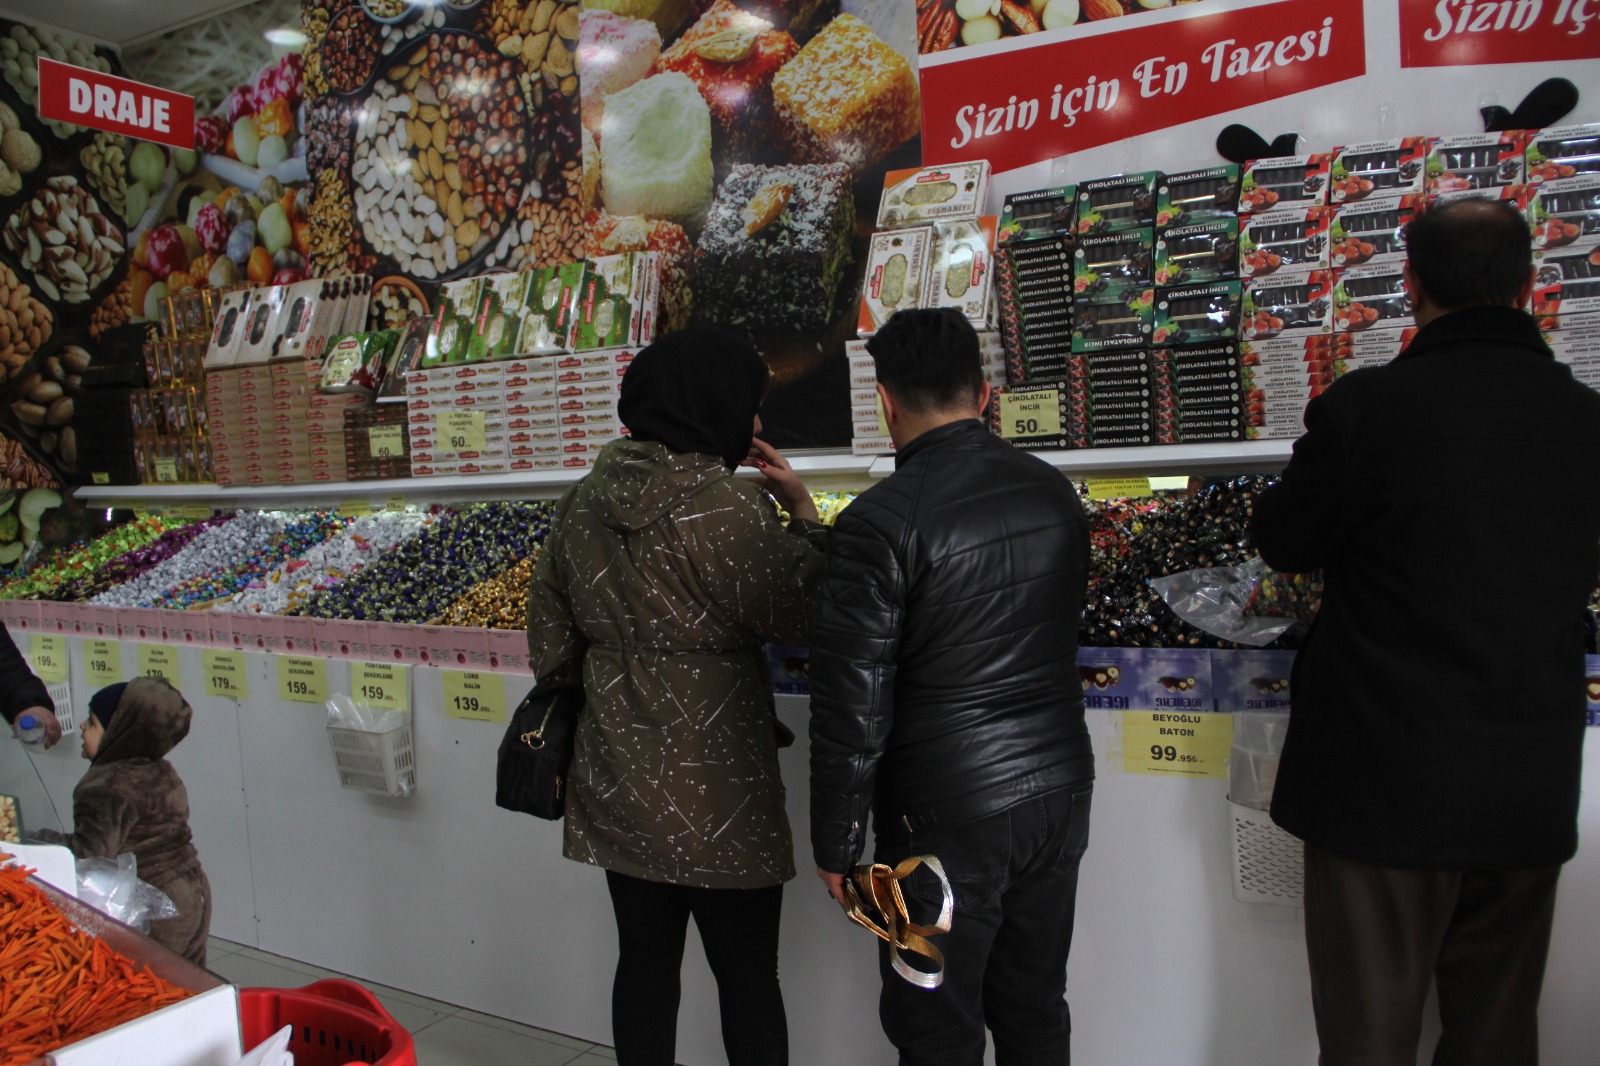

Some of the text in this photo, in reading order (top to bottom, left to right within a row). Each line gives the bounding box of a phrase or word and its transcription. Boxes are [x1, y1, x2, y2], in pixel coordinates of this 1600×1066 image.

[1424, 0, 1600, 42] Sizin iç
[951, 16, 1333, 149] Sizin için En Tazesi
[69, 77, 170, 133] DRAJE
[1087, 175, 1145, 190] ÇİKOLATALI İNCİR
[1167, 168, 1227, 184] ÇİKOLATALI İNCİR
[1012, 189, 1065, 203] ÇİKOLATALI İNCİR
[1122, 232, 1141, 240] İNCİR
[1168, 285, 1229, 299] ÇİKOLATALI İNCİR
[1008, 394, 1051, 403] ÇİKOLATALI
[1020, 403, 1040, 411] İNCİR
[1015, 419, 1038, 434] 50
[1153, 713, 1201, 724] BEYOĞLU
[1159, 727, 1195, 737] BATON
